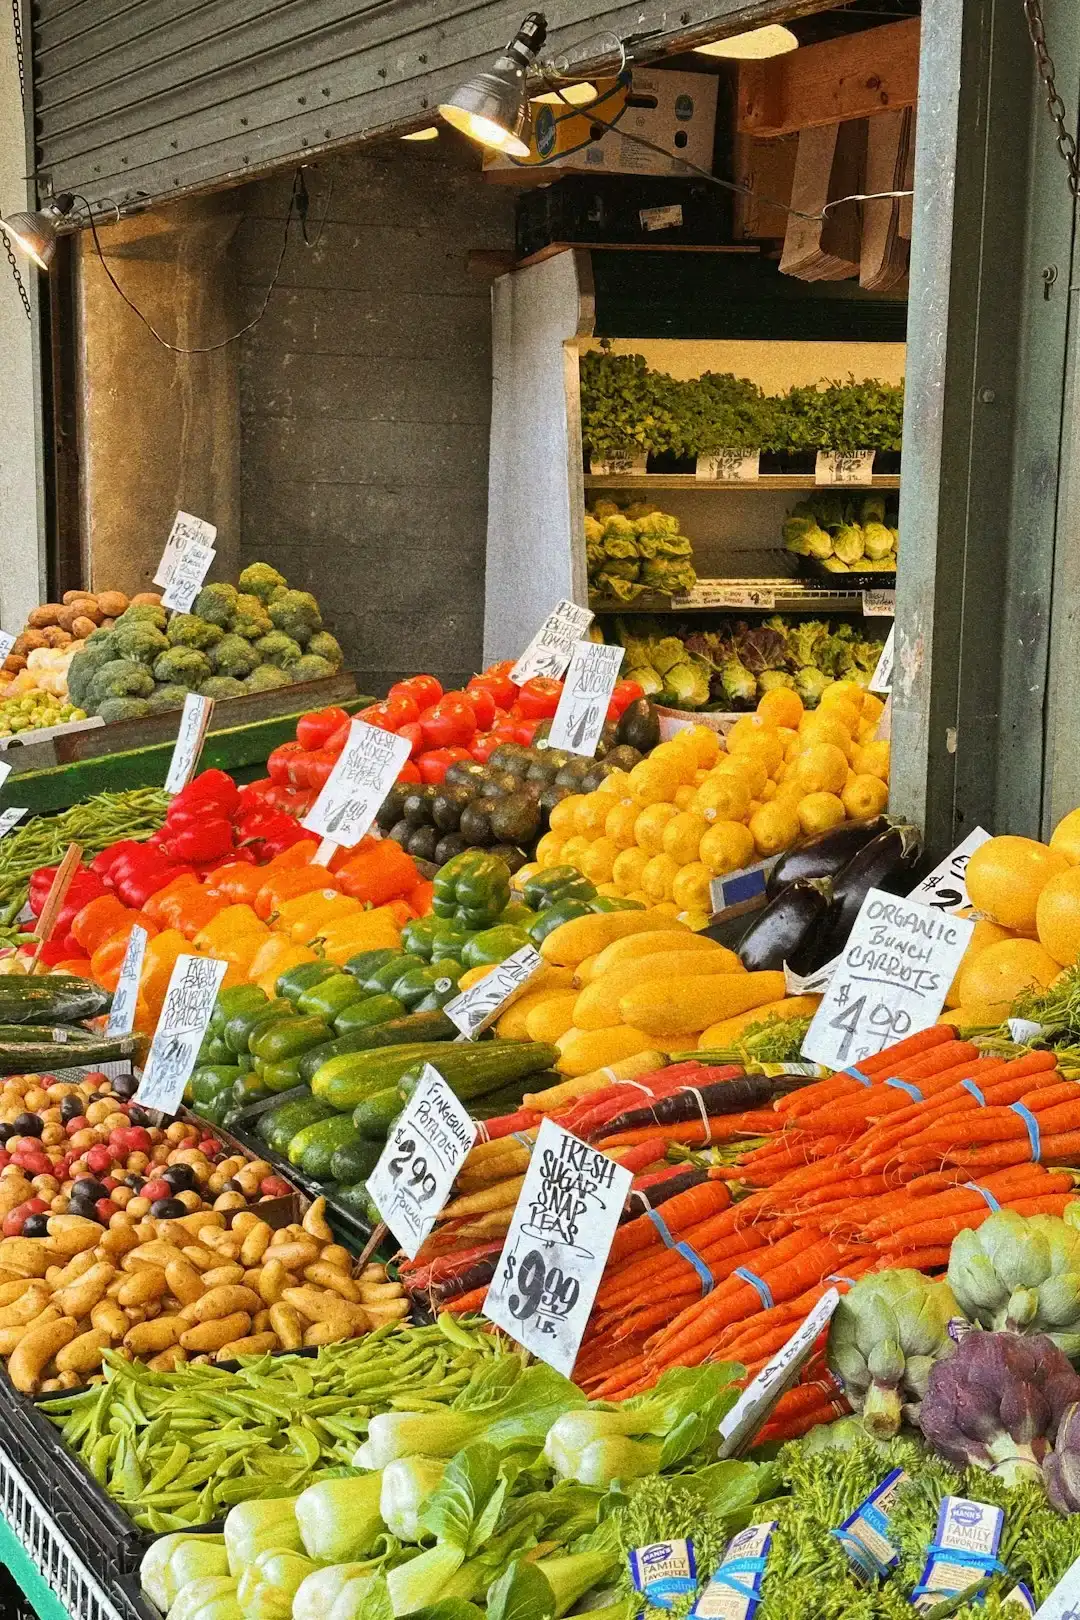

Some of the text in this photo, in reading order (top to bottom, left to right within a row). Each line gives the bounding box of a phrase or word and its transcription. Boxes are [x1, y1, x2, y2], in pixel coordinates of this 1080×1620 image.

[356, 740, 395, 763] MIXED
[365, 727, 397, 750] FRESH
[347, 748, 390, 778] SWEET
[866, 900, 957, 946] ORGANIC
[186, 957, 217, 978] FRESH
[846, 945, 942, 991] CARROTS
[180, 975, 216, 990] BABY
[167, 985, 216, 1009] RAINBOW
[426, 1082, 473, 1152] FINGERLING
[413, 1100, 460, 1167] POTATOES
[560, 1134, 617, 1189] FRESH
[539, 1148, 606, 1209] SUGAR
[537, 1179, 587, 1220] SNAP
[528, 1201, 579, 1245] PEAS
[945, 1535, 989, 1552] FAVORITES
[949, 1524, 991, 1543] FAMILY
[643, 1559, 687, 1575] FAMILY
[645, 1569, 689, 1583] FAVORITES
